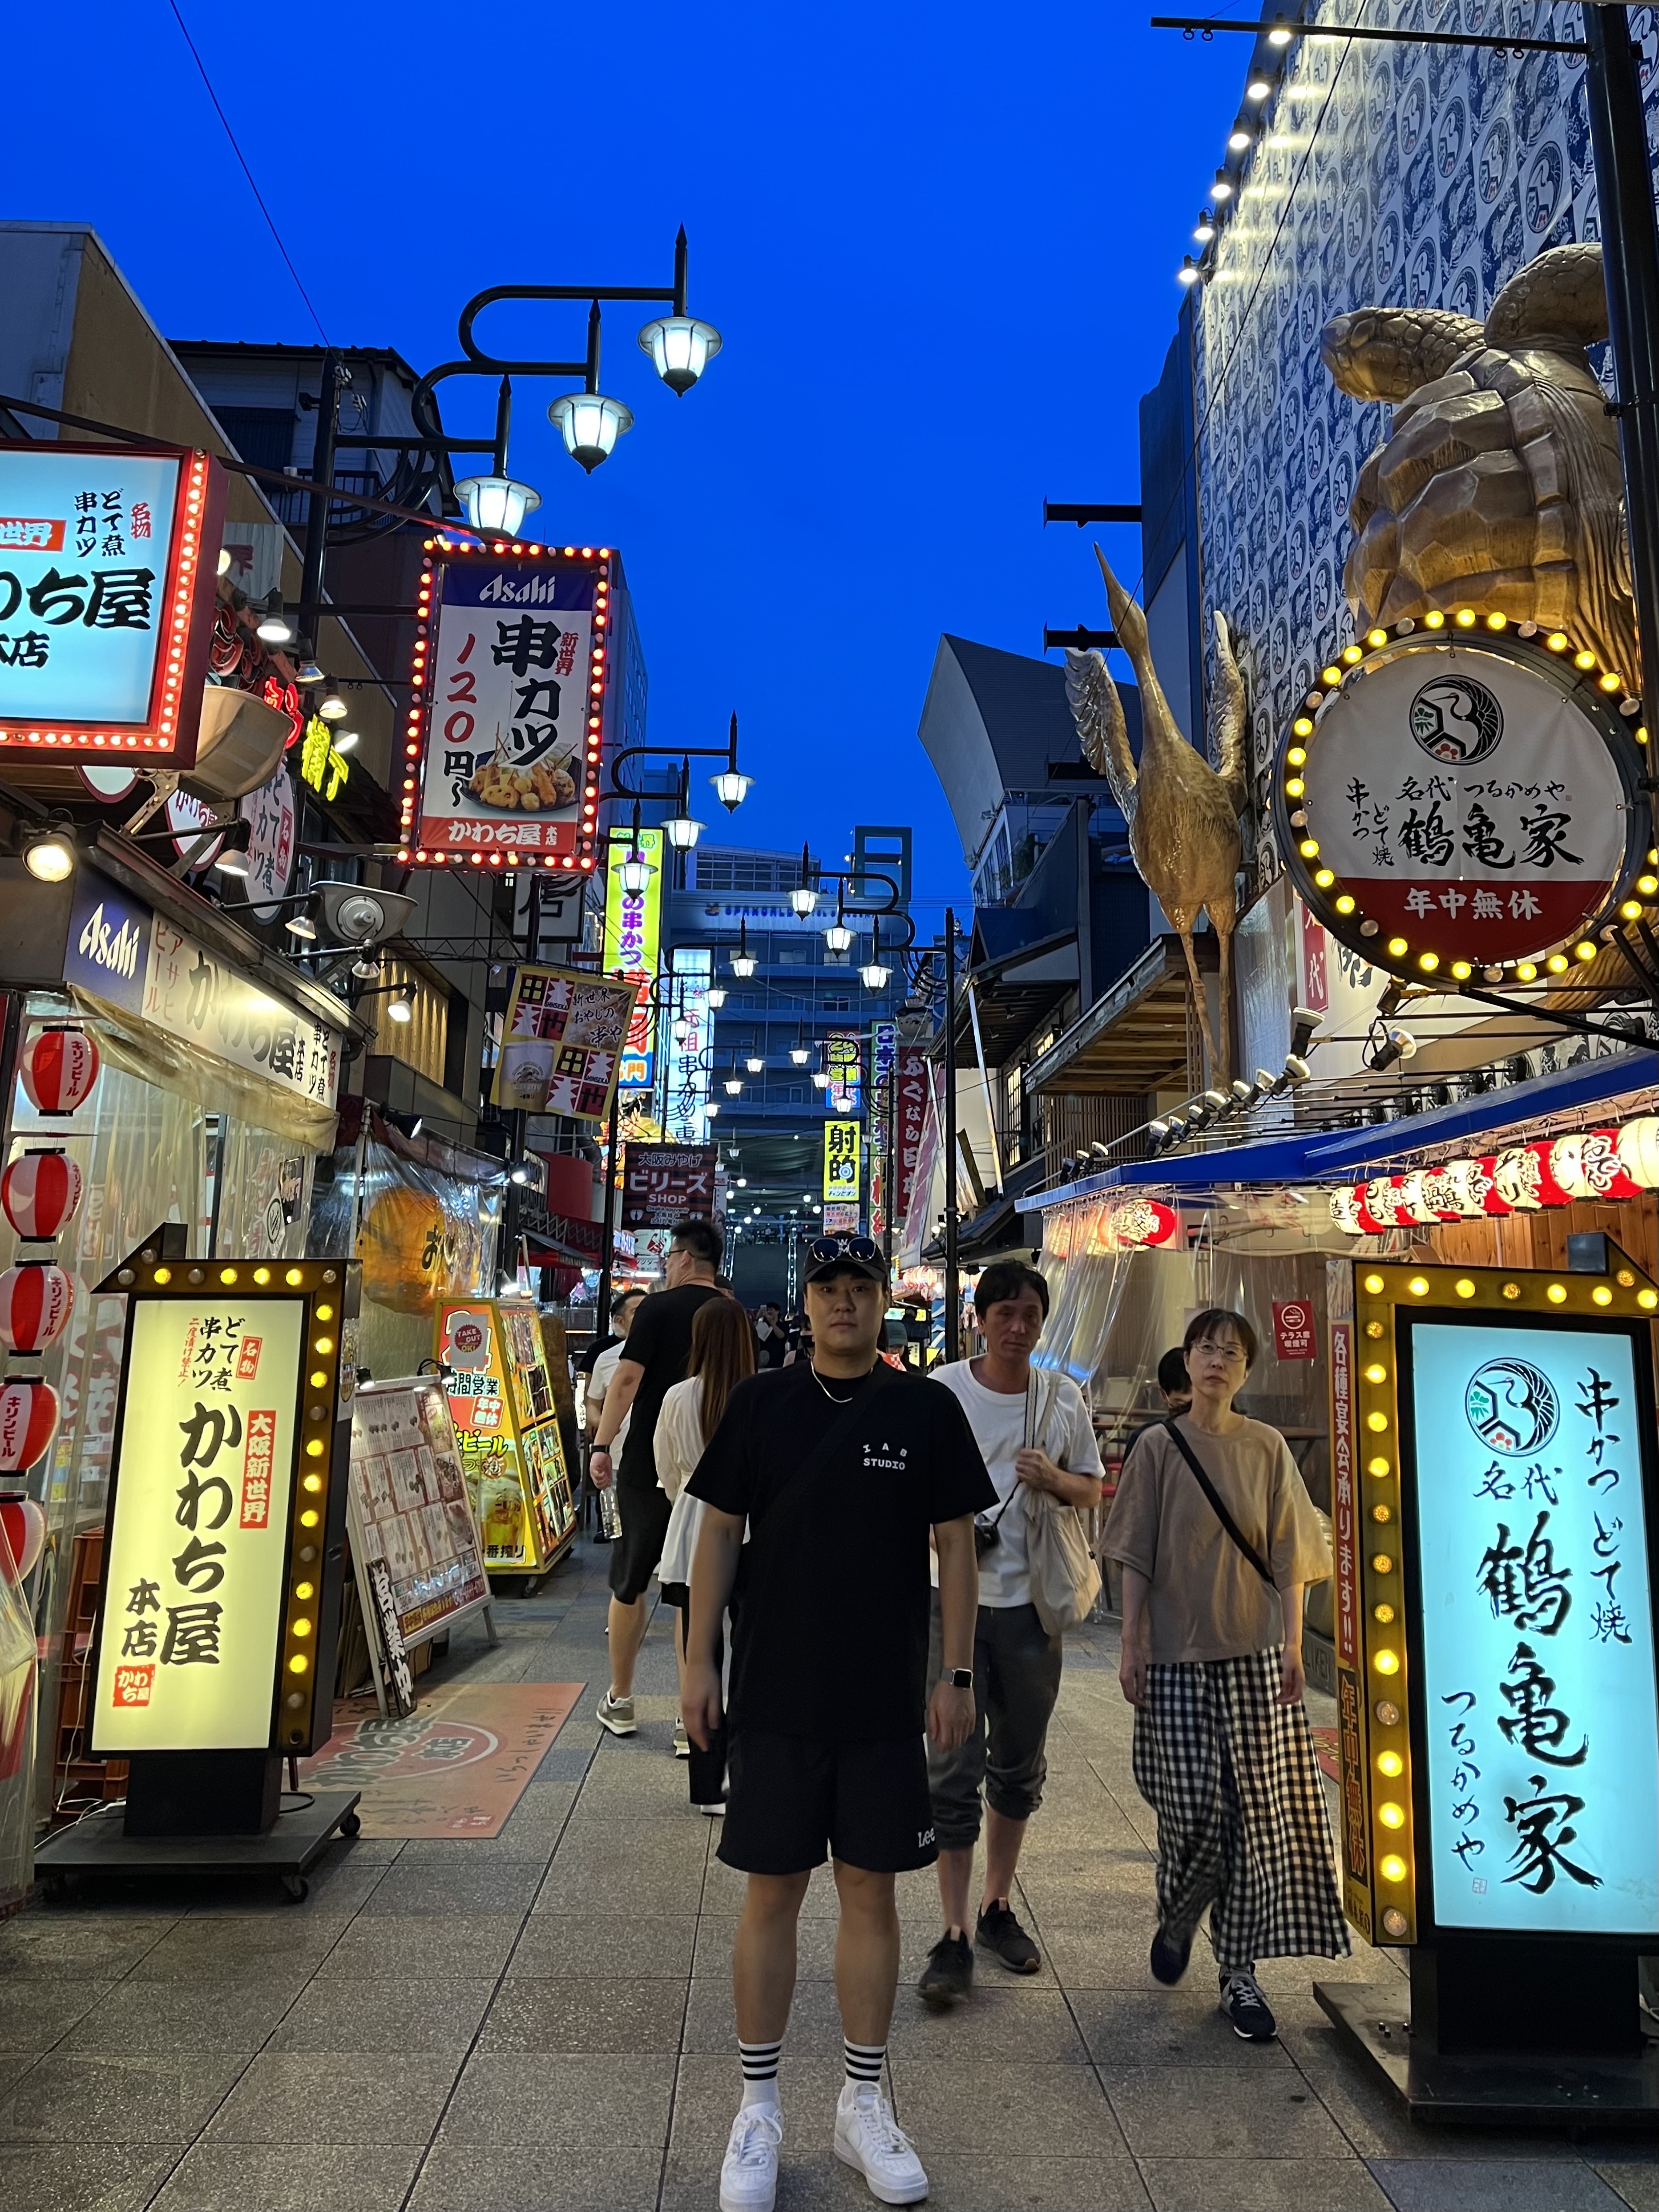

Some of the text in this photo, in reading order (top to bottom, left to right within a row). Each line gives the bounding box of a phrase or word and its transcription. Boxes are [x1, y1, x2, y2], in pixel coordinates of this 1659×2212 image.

[74, 490, 98, 558] 串カツ
[100, 487, 126, 558] どて煮
[130, 501, 152, 540] 名物
[478, 573, 556, 604] Asahi
[554, 631, 579, 677] 新世界
[491, 613, 562, 768] 串カツ
[1346, 777, 1371, 841] 串かつ
[1395, 774, 1455, 801] 名代
[1463, 778, 1567, 802] つるかめや
[447, 820, 542, 847] かわち屋
[544, 825, 558, 847] 本店
[1371, 802, 1395, 867] どて焼
[1397, 801, 1585, 869] 鶴亀家
[1403, 887, 1543, 921] 年中無休
[78, 901, 141, 980] Asahi
[145, 920, 170, 1014] ビール
[572, 987, 611, 1007] 新世界
[573, 1006, 615, 1025] おやじの
[65, 1039, 84, 1097] キリンビール
[294, 1036, 306, 1083] 本店
[638, 1152, 703, 1168] 大阪みやげ
[828, 1124, 857, 1184] 射的
[629, 1169, 708, 1194] ビリーズ
[648, 1193, 687, 1204] SHOP
[42, 1275, 66, 1337] キリンビール
[192, 1316, 223, 1389] 串カツ
[209, 1315, 246, 1392] どて煮
[240, 1342, 257, 1374] 名物
[457, 1328, 478, 1338] TAKE
[461, 1345, 476, 1353] OK!
[465, 1334, 482, 1343] OUT
[1, 1395, 22, 1458] キリンビール
[477, 1398, 502, 1414] 年中
[1573, 1366, 1621, 1496] 串かつ
[242, 1412, 273, 1523] 大阪新世界
[863, 1457, 906, 1471] STUDIO
[1472, 1459, 1564, 1507] 名代
[159, 1400, 243, 1666] かわち屋
[1589, 1510, 1633, 1644] どて焼
[120, 1577, 162, 1658] 本店
[1476, 1509, 1605, 1896] 鶴亀家
[1341, 1673, 1366, 1878] 年中無休
[1440, 1690, 1486, 1873] つるかめや
[918, 1827, 935, 1848] Lee
